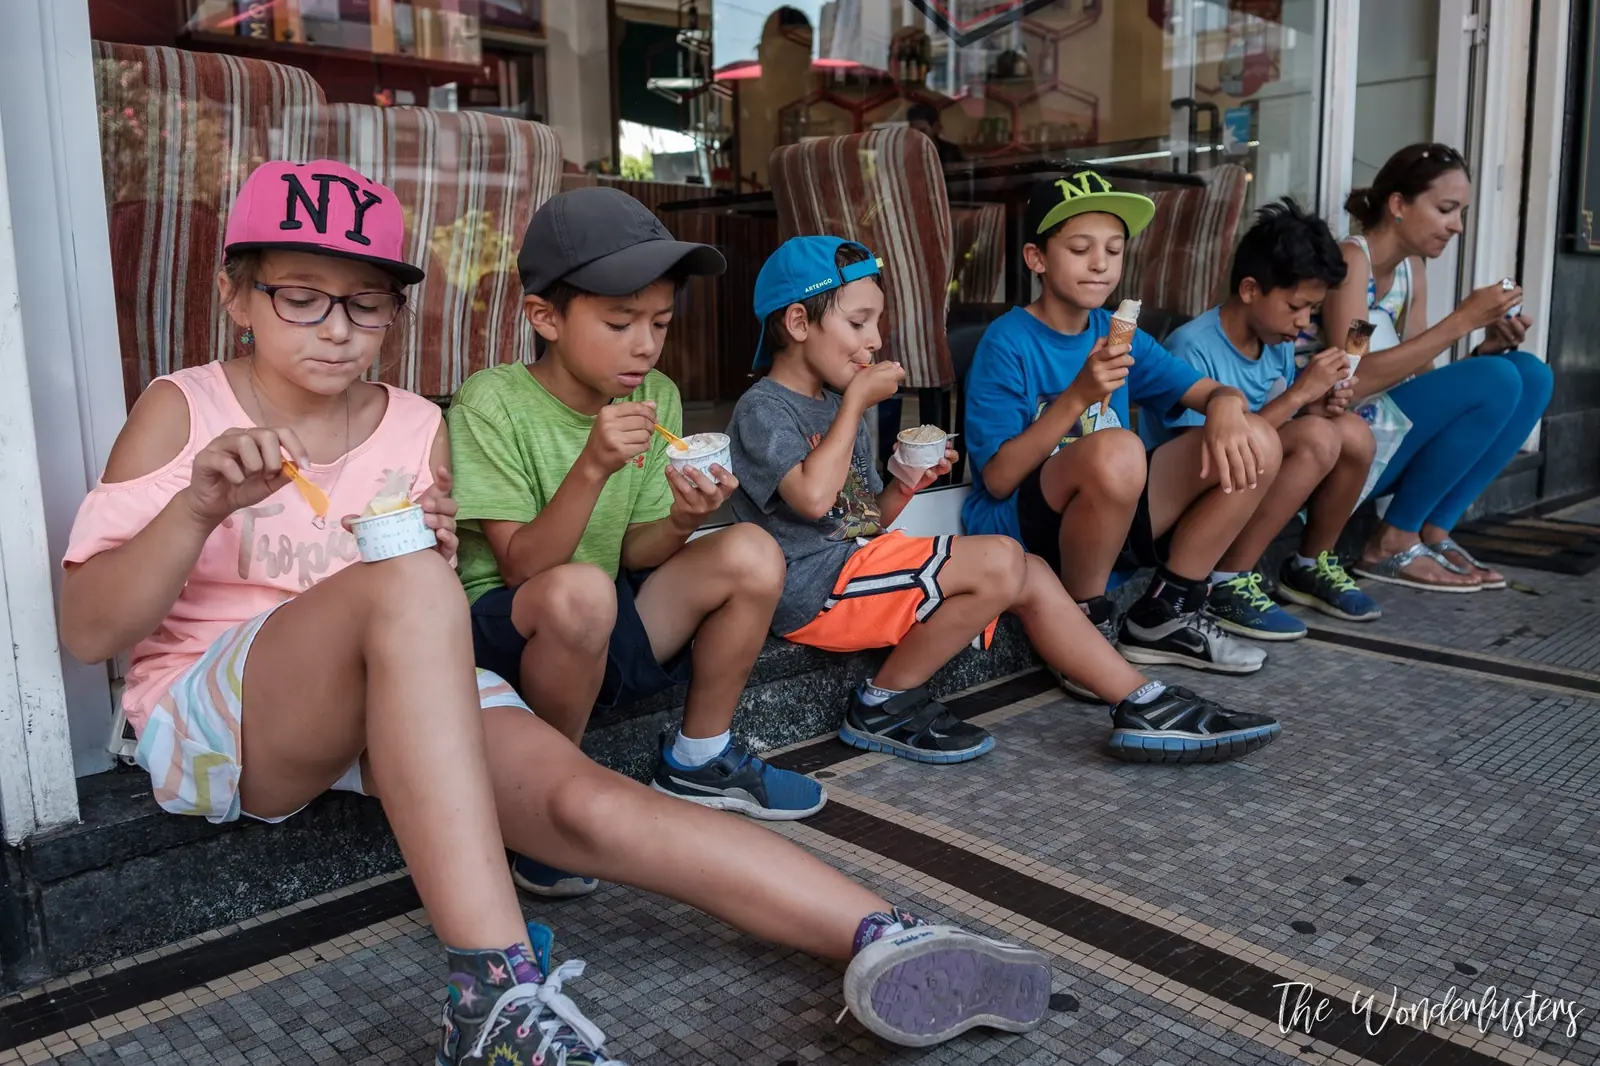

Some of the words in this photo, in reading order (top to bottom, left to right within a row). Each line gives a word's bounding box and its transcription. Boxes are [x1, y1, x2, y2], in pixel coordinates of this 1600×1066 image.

[280, 173, 382, 246] NY
[804, 278, 833, 293] ARTENGO
[1137, 681, 1161, 697] USA
